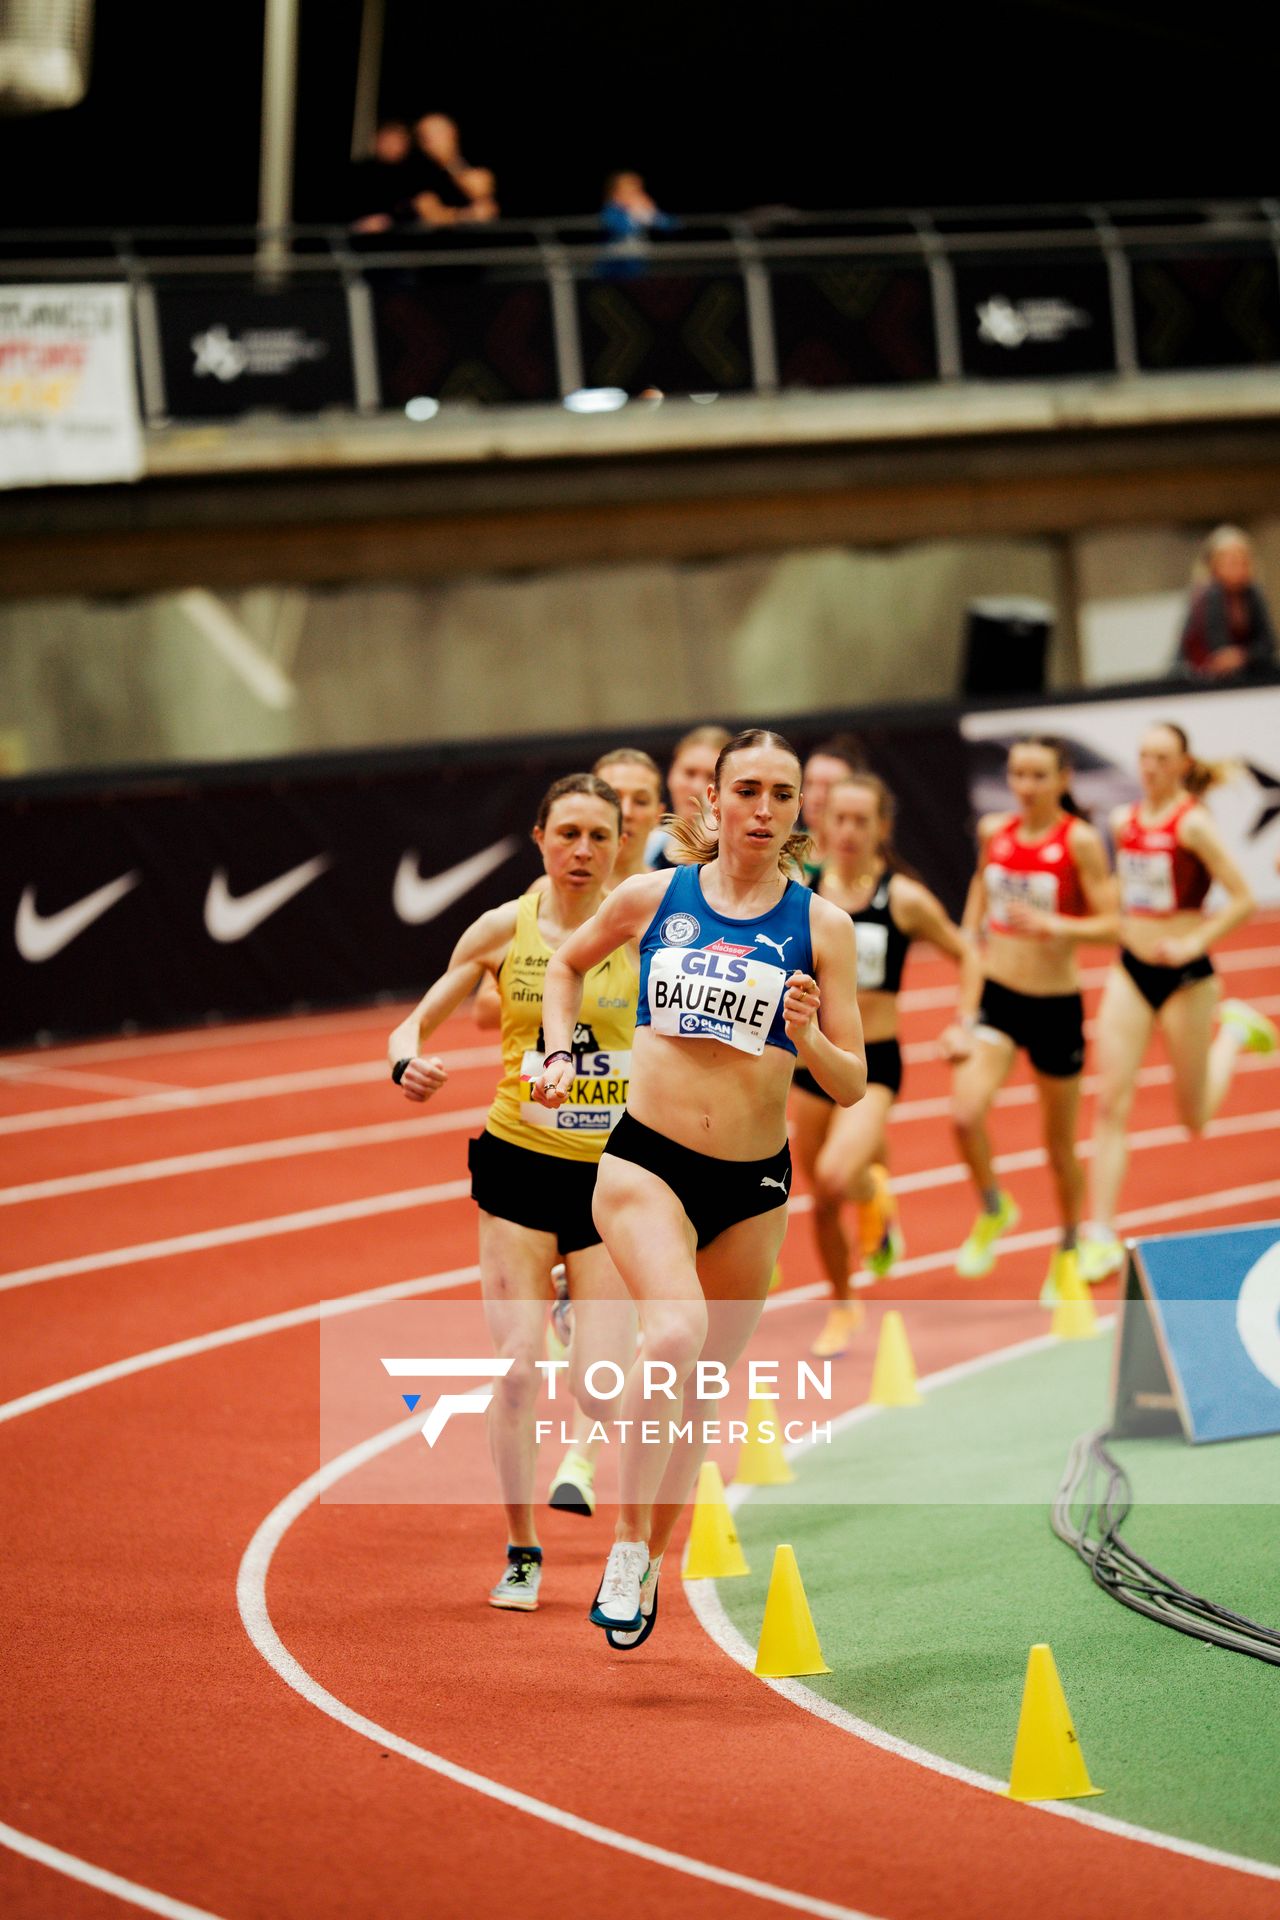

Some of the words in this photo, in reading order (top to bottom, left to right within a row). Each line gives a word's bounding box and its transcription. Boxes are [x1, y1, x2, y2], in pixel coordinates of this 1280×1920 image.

[655, 975, 769, 1028] BÄUERLE
[700, 1018, 731, 1035] PLAN
[579, 1113, 609, 1124] PLAN
